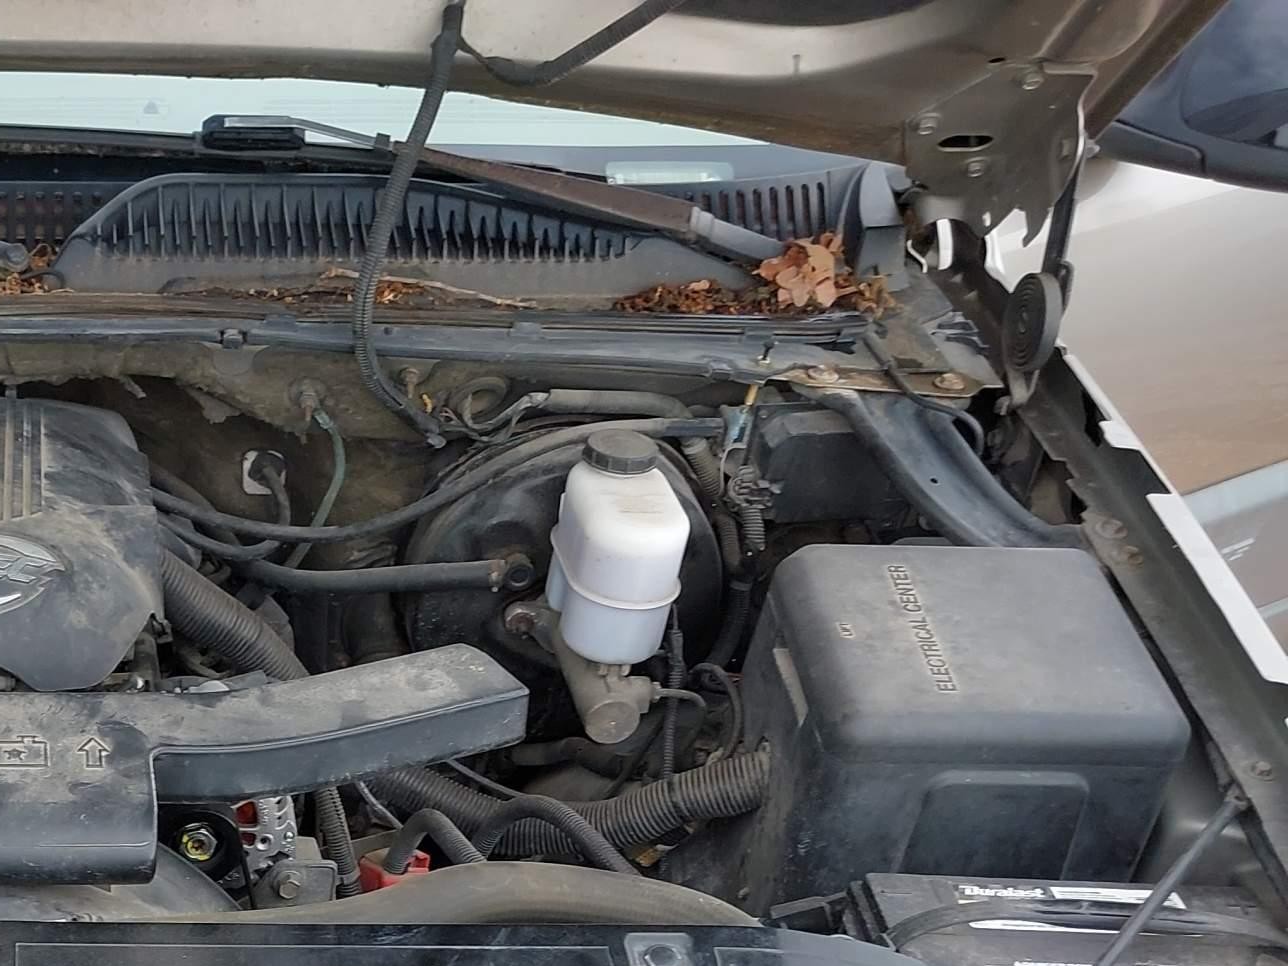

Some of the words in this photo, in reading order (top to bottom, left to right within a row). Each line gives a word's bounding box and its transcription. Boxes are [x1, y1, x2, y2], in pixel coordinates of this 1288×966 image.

[887, 564, 923, 613] CENTER
[909, 616, 957, 692] ELECTRICAL
[964, 885, 1046, 898] Duralast
